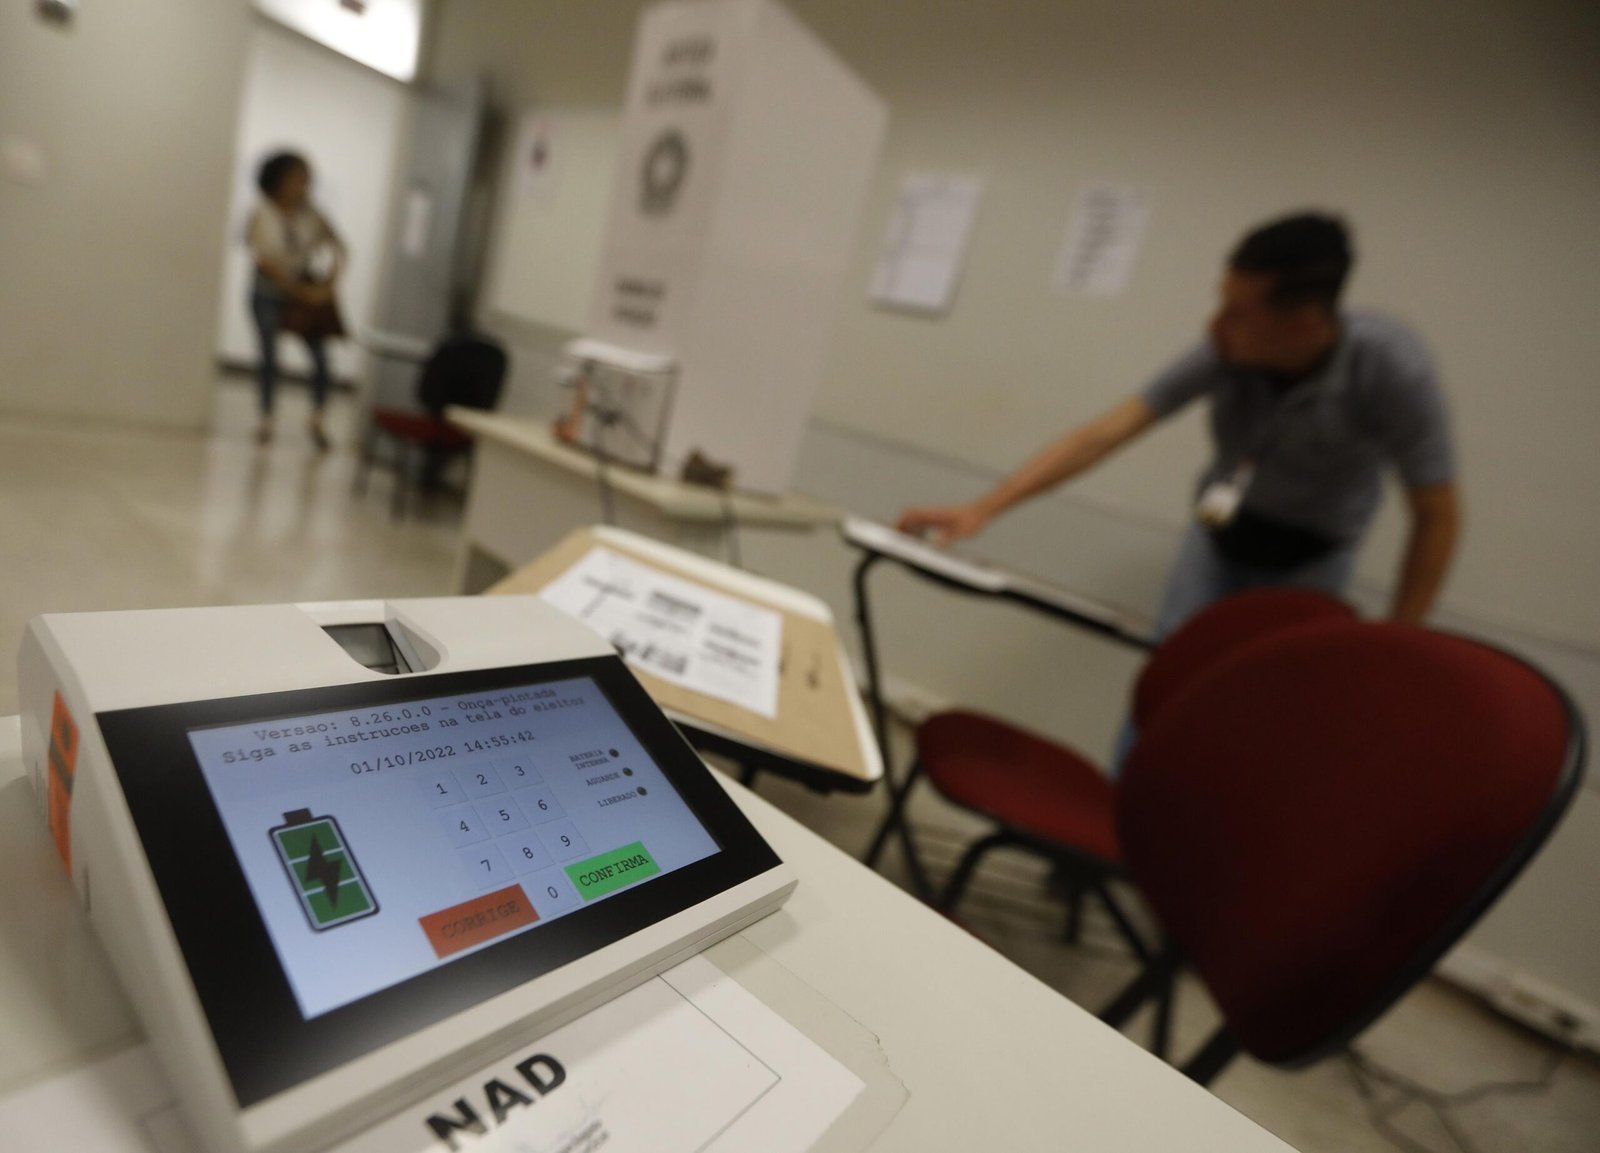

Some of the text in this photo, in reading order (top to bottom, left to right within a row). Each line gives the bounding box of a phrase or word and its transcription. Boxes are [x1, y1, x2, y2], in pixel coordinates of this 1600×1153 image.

[222, 696, 586, 764] Siga as instrucoes na tela do eleitor
[254, 721, 338, 741] Versao:
[351, 705, 432, 727] 8.26.0.0
[350, 730, 536, 775] 01/10/2022 14:55:42
[569, 749, 604, 762] BATERIA
[436, 765, 526, 795] 1 2 3
[460, 799, 548, 832] 4 5 6
[597, 791, 637, 807] LIBERADO
[480, 835, 571, 872] 7 8 9
[441, 854, 649, 939] CORRIGE 0 CONFIRMA
[425, 1053, 567, 1152] NAD
